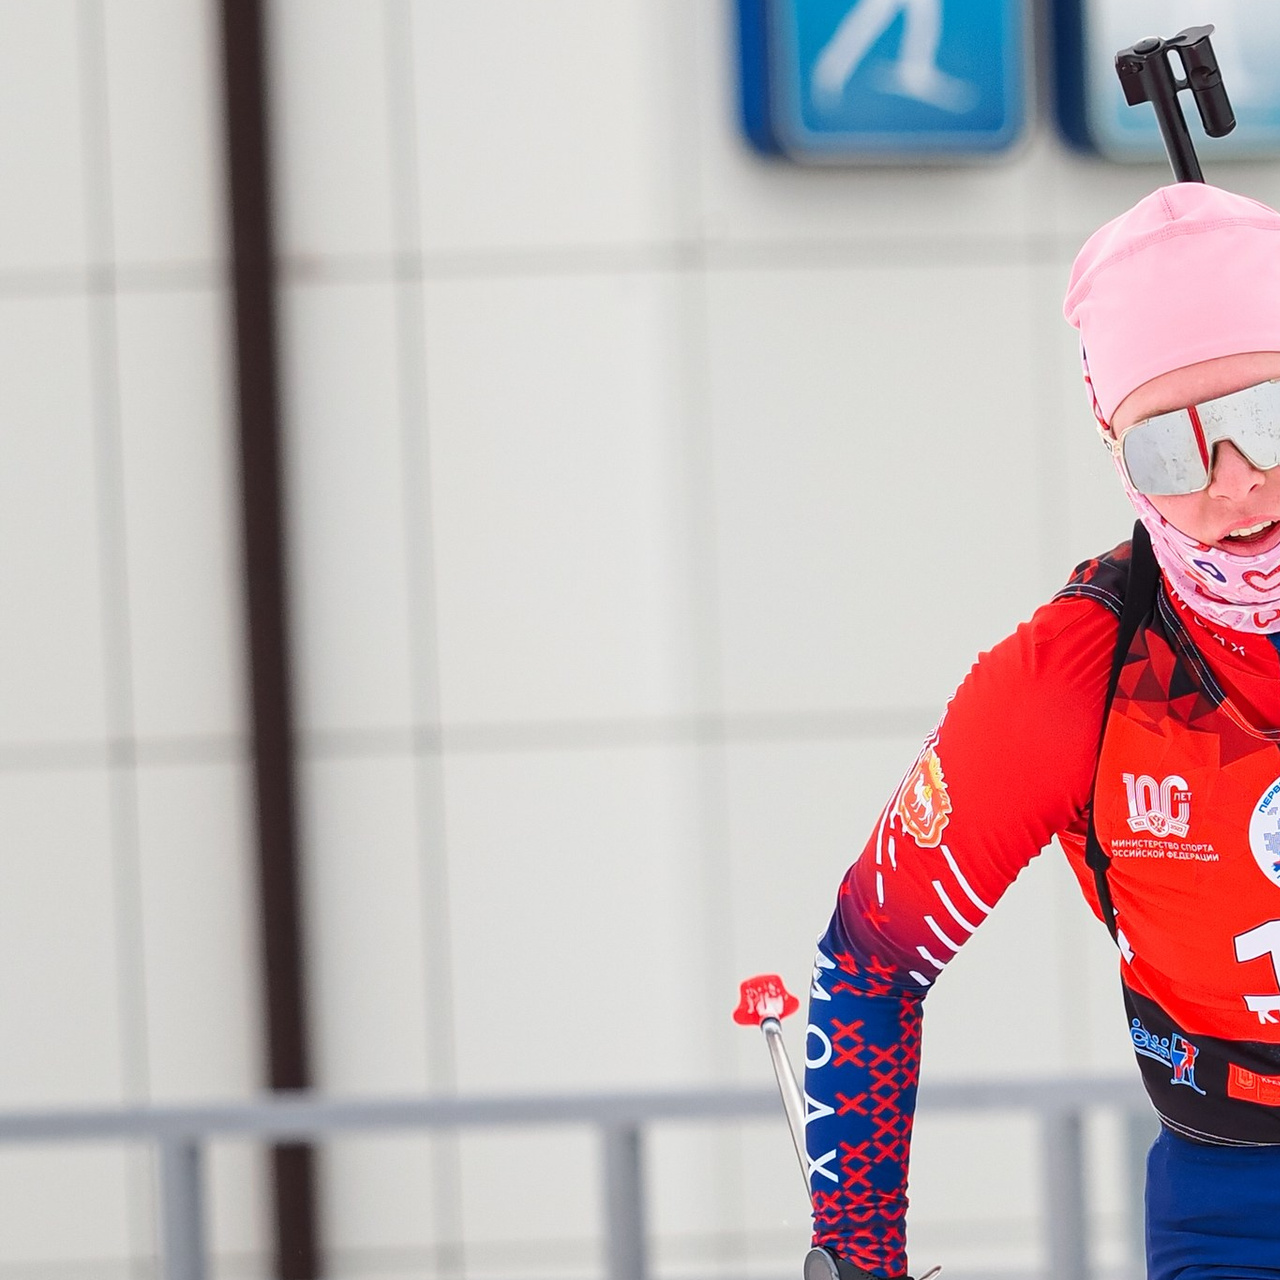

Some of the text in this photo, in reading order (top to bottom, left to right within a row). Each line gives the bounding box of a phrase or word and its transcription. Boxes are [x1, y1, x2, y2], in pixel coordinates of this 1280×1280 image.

[1122, 772, 1190, 825] 100
[1173, 792, 1193, 802] ЛЕТ
[1111, 839, 1214, 853] МИНИСТЕРСТВО СПОРТА
[1111, 847, 1220, 862] ОССИЙСКОЙ ФЕДЕРАЦИИ
